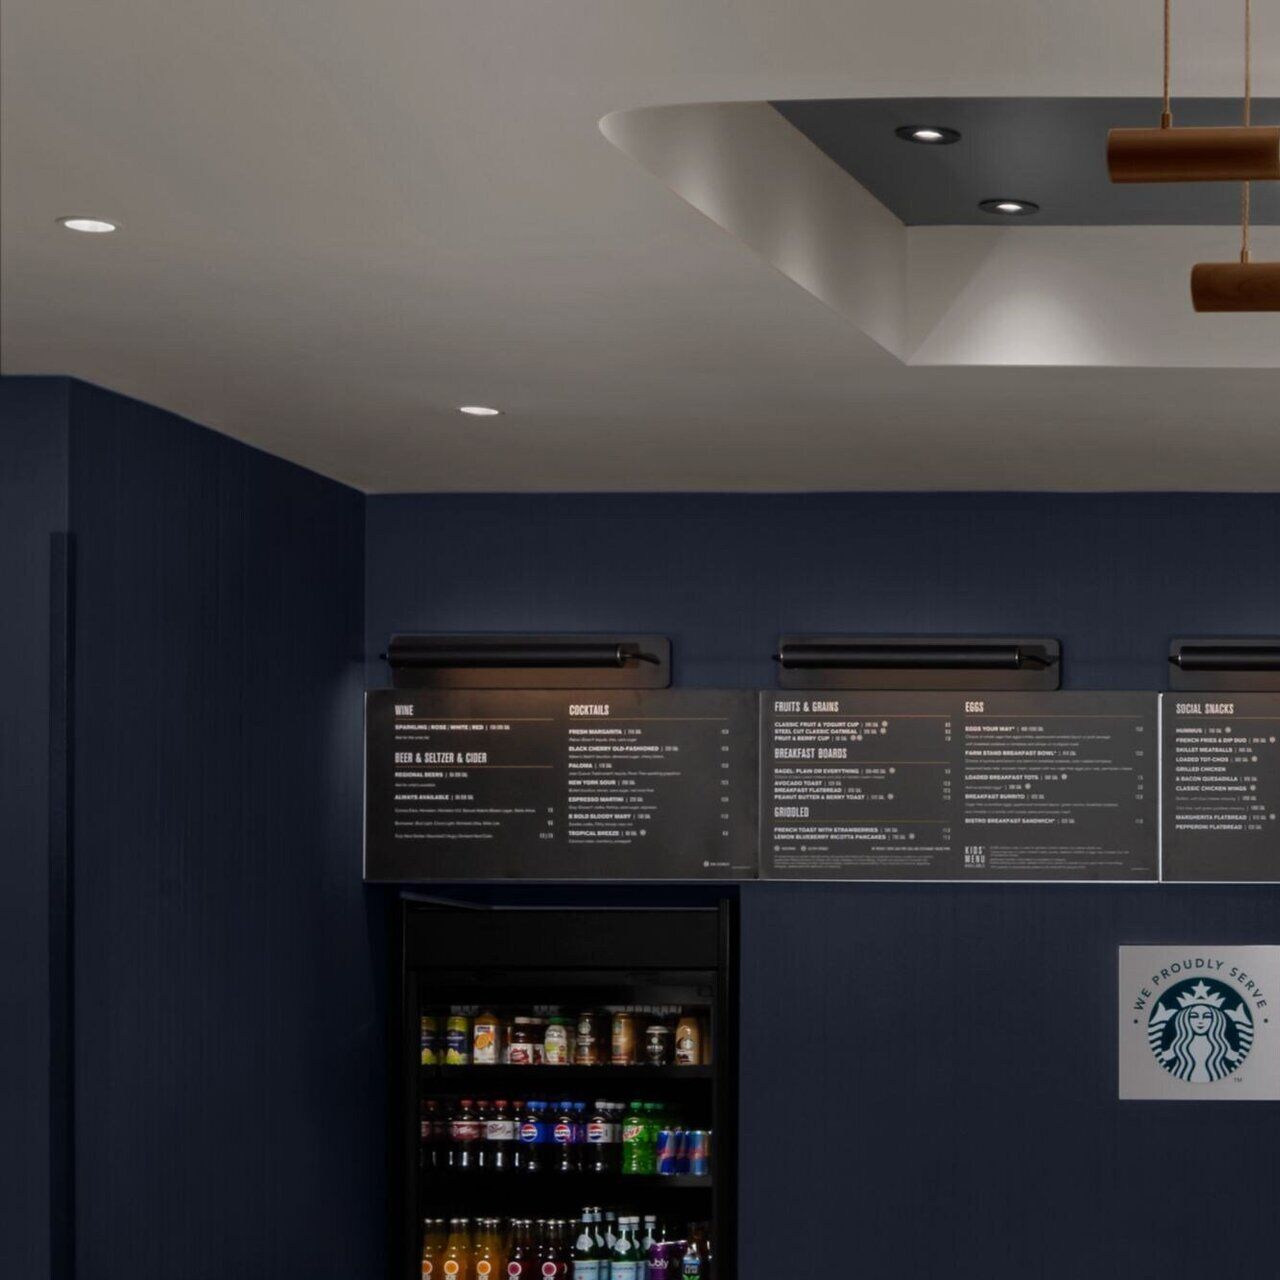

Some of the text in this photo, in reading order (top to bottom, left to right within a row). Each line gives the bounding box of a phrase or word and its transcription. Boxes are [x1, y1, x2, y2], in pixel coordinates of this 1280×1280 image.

[395, 705, 414, 716] WINE
[569, 705, 609, 716] COCKTAILS
[774, 701, 839, 712] FRUITS & GRAINS
[965, 701, 984, 712] EGGS
[1176, 703, 1234, 714] SOCIAL SNACKS
[395, 752, 487, 763] BEER & SELTZER & CIDER
[774, 748, 847, 758] BREAKFAST BOARDS
[774, 807, 809, 818] GRIDDLED
[965, 855, 985, 863] MENU
[1134, 958, 1268, 1010] WE PROUDLY SERVE
